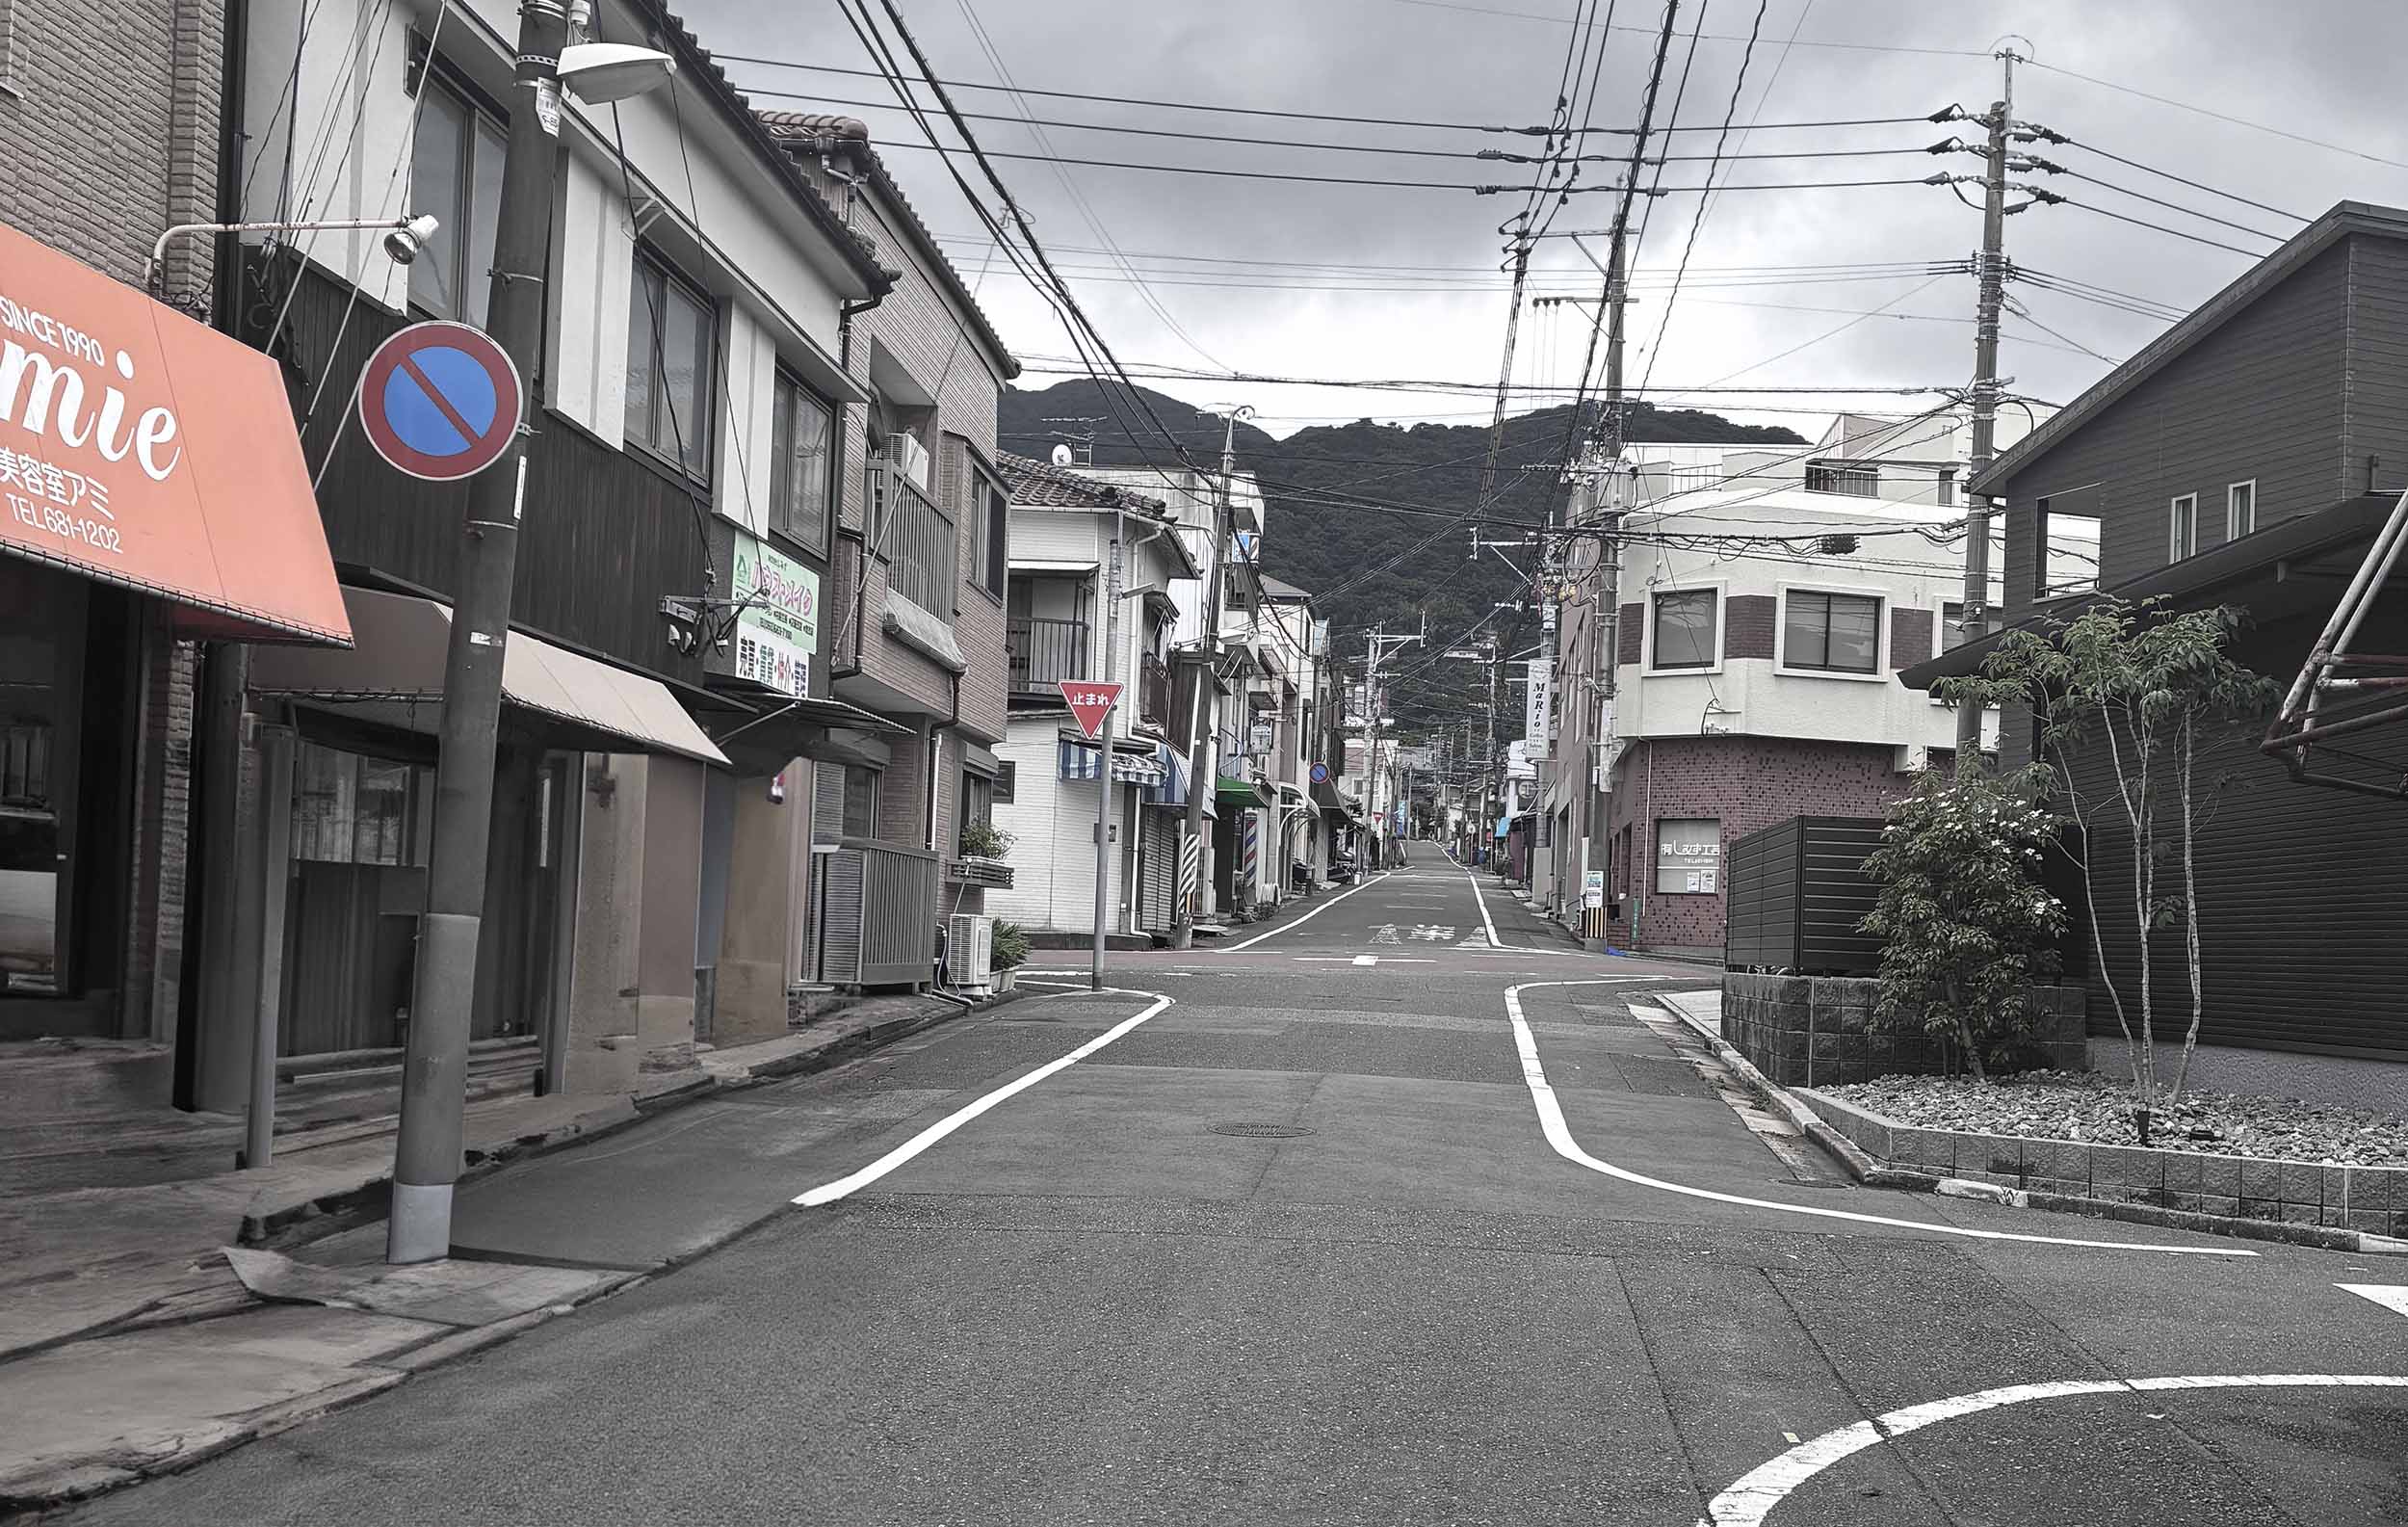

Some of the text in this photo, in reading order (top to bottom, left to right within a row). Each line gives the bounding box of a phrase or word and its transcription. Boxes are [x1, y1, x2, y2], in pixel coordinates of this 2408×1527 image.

[0, 296, 105, 367] SINCE 1990
[0, 447, 115, 520] 美容室アミ
[1072, 692, 1110, 706] 止まれ
